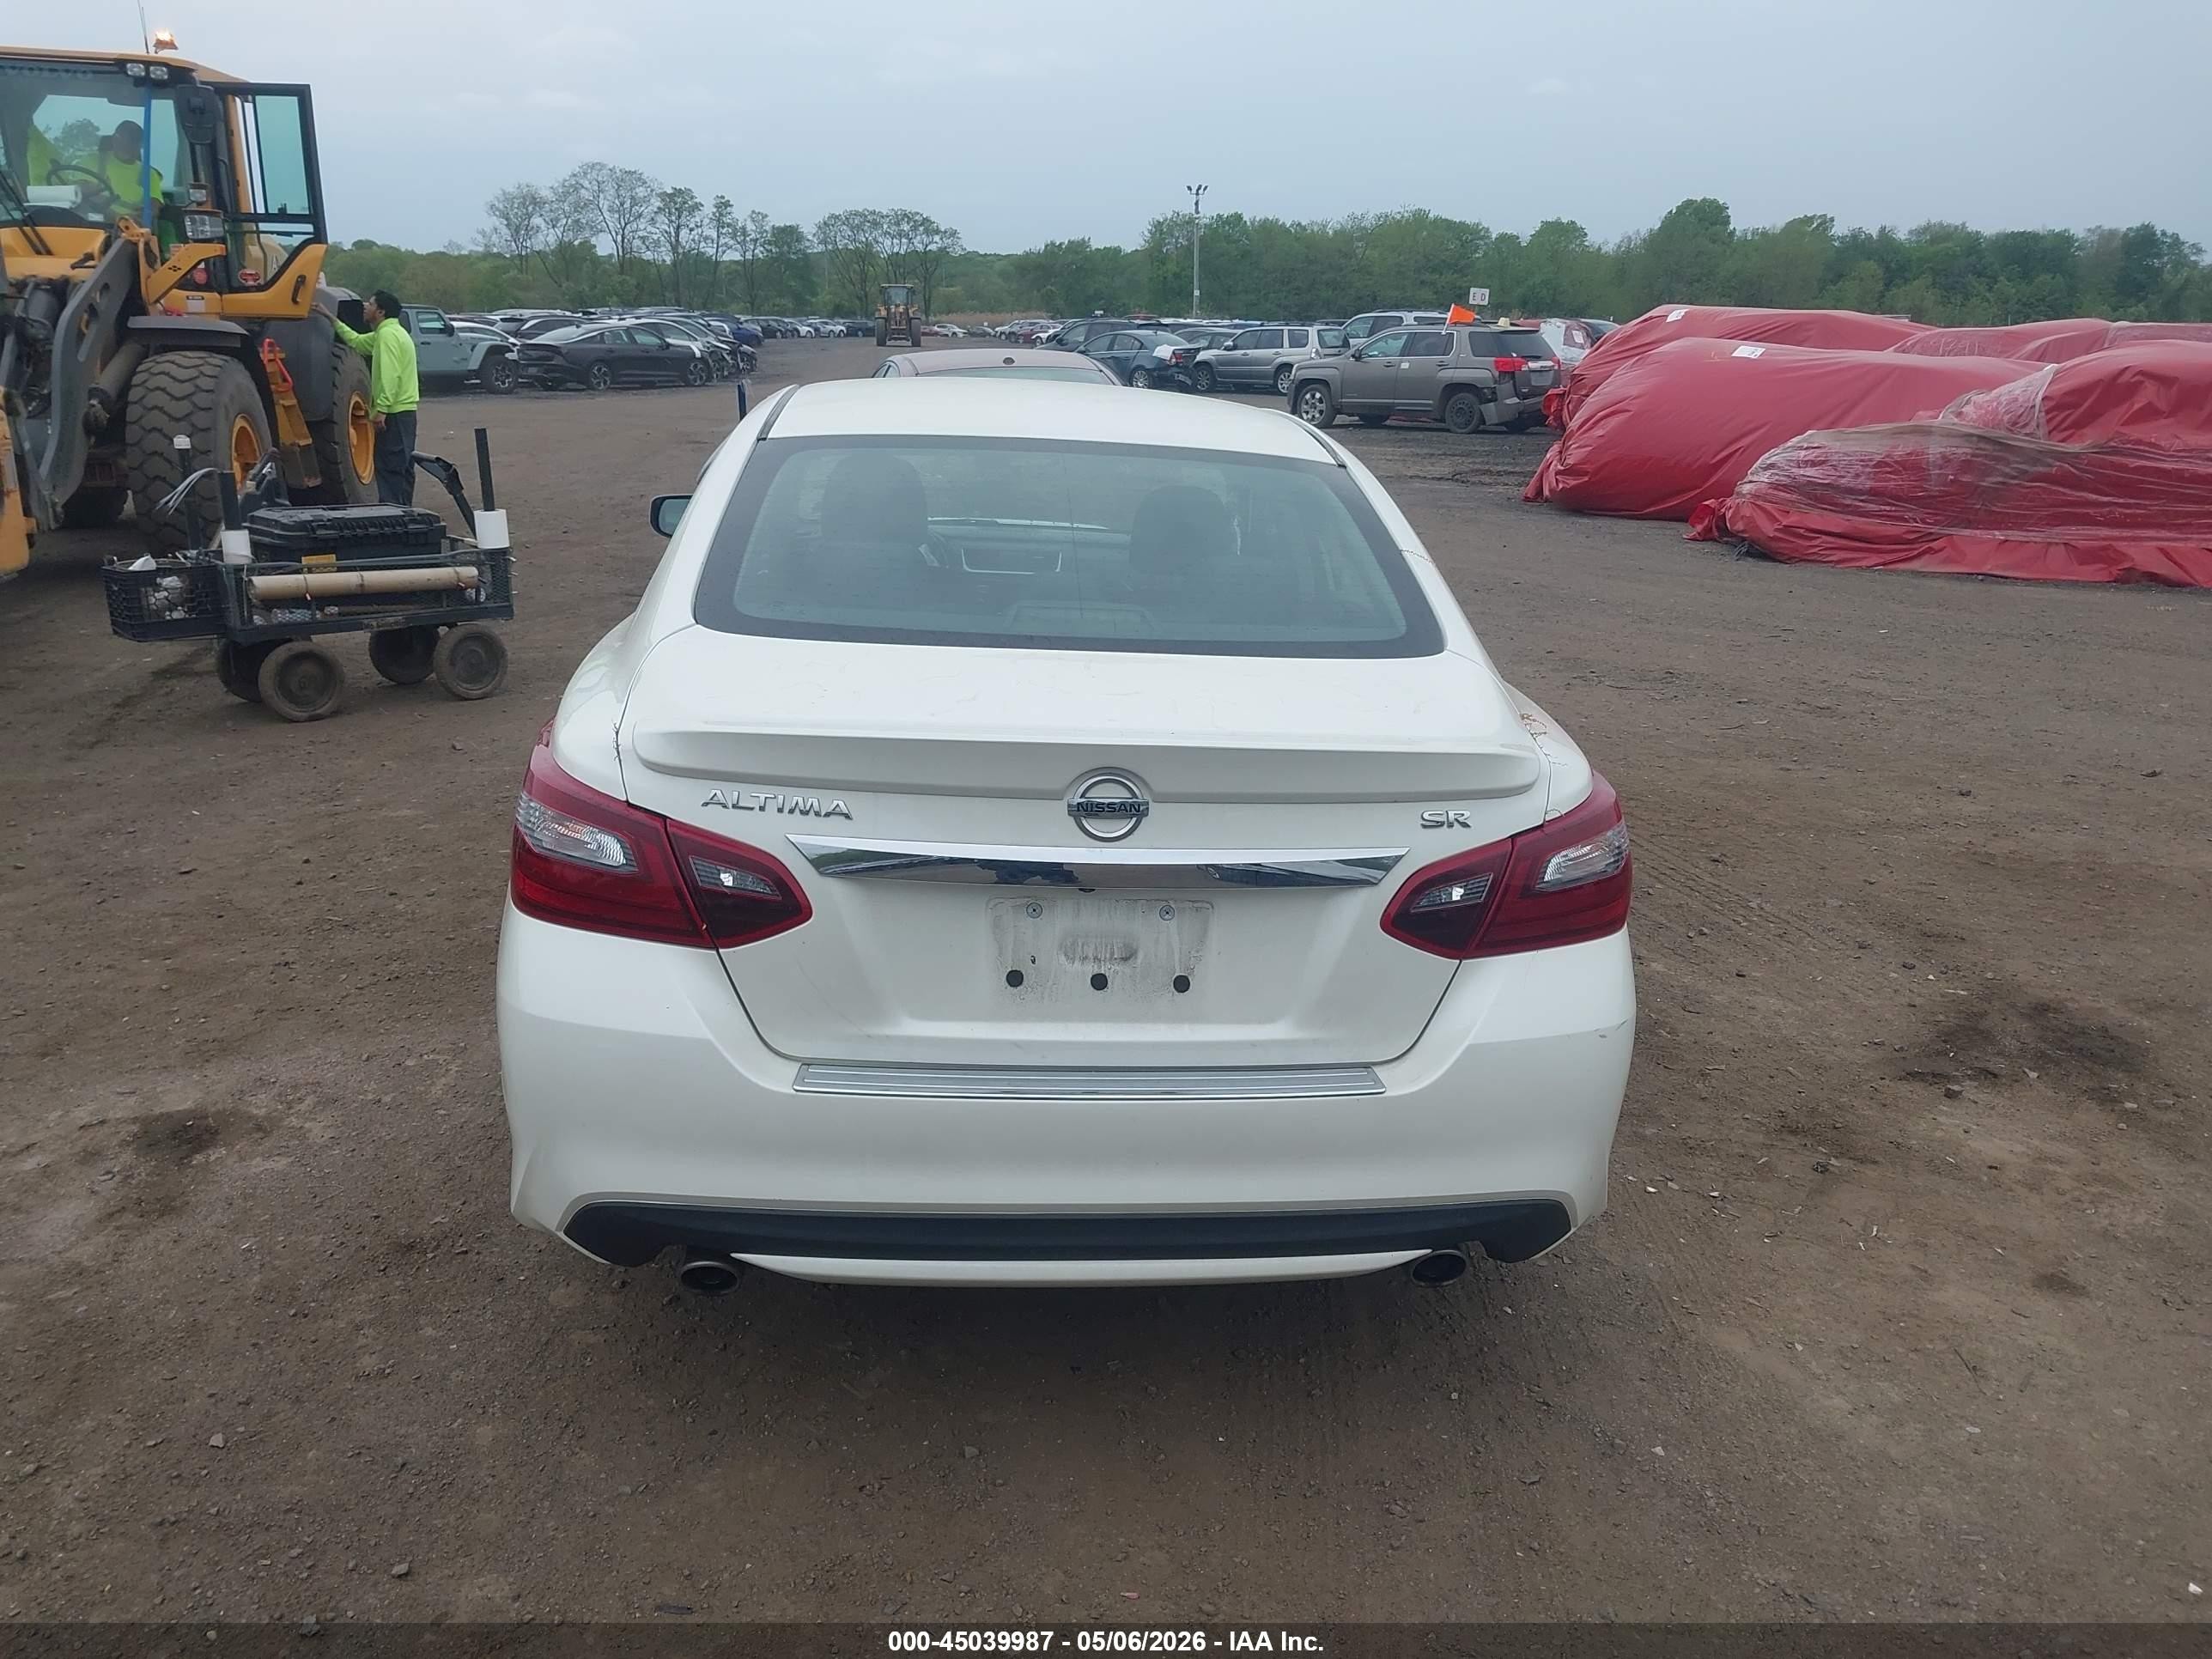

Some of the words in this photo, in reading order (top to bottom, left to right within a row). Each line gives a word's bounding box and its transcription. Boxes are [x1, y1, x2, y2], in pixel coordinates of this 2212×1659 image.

[701, 788, 854, 821] ALTIMA
[1076, 801, 1141, 813] NISSAN
[1420, 810, 1472, 829] SR
